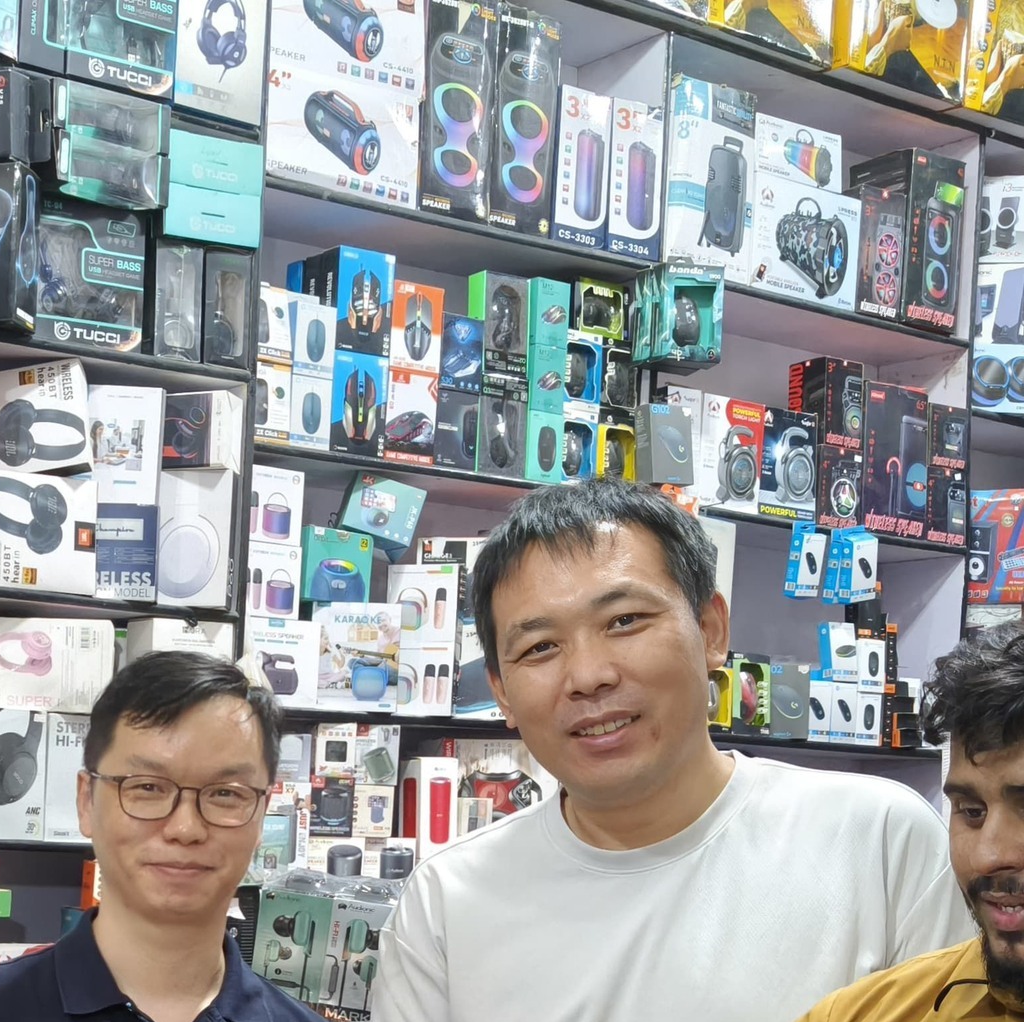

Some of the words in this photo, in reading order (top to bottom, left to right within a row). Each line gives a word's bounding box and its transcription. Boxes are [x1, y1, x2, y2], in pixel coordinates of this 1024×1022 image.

[150, 0, 172, 14] BASS
[270, 46, 306, 63] PEAKER
[107, 66, 152, 88] TUCCI
[422, 198, 451, 212] SPEAKER
[490, 214, 517, 227] SPEAKER
[558, 228, 596, 247] CS-3303
[612, 238, 650, 256] CS-3304
[88, 254, 115, 268] SUPER
[116, 260, 142, 273] BASS
[784, 283, 806, 294] SPEAKER
[73, 327, 122, 346] TUCCI
[38, 367, 46, 390] hear
[61, 362, 74, 400] WIRELESS
[789, 364, 804, 413] OUND
[732, 408, 761, 418] POWERFUL
[760, 505, 798, 518] POWERFUL
[114, 586, 151, 598] MODEL
[334, 615, 382, 625] KARAOKE
[7, 695, 52, 708] SUPER
[26, 807, 42, 816] ANC
[300, 810, 308, 830] JUST
